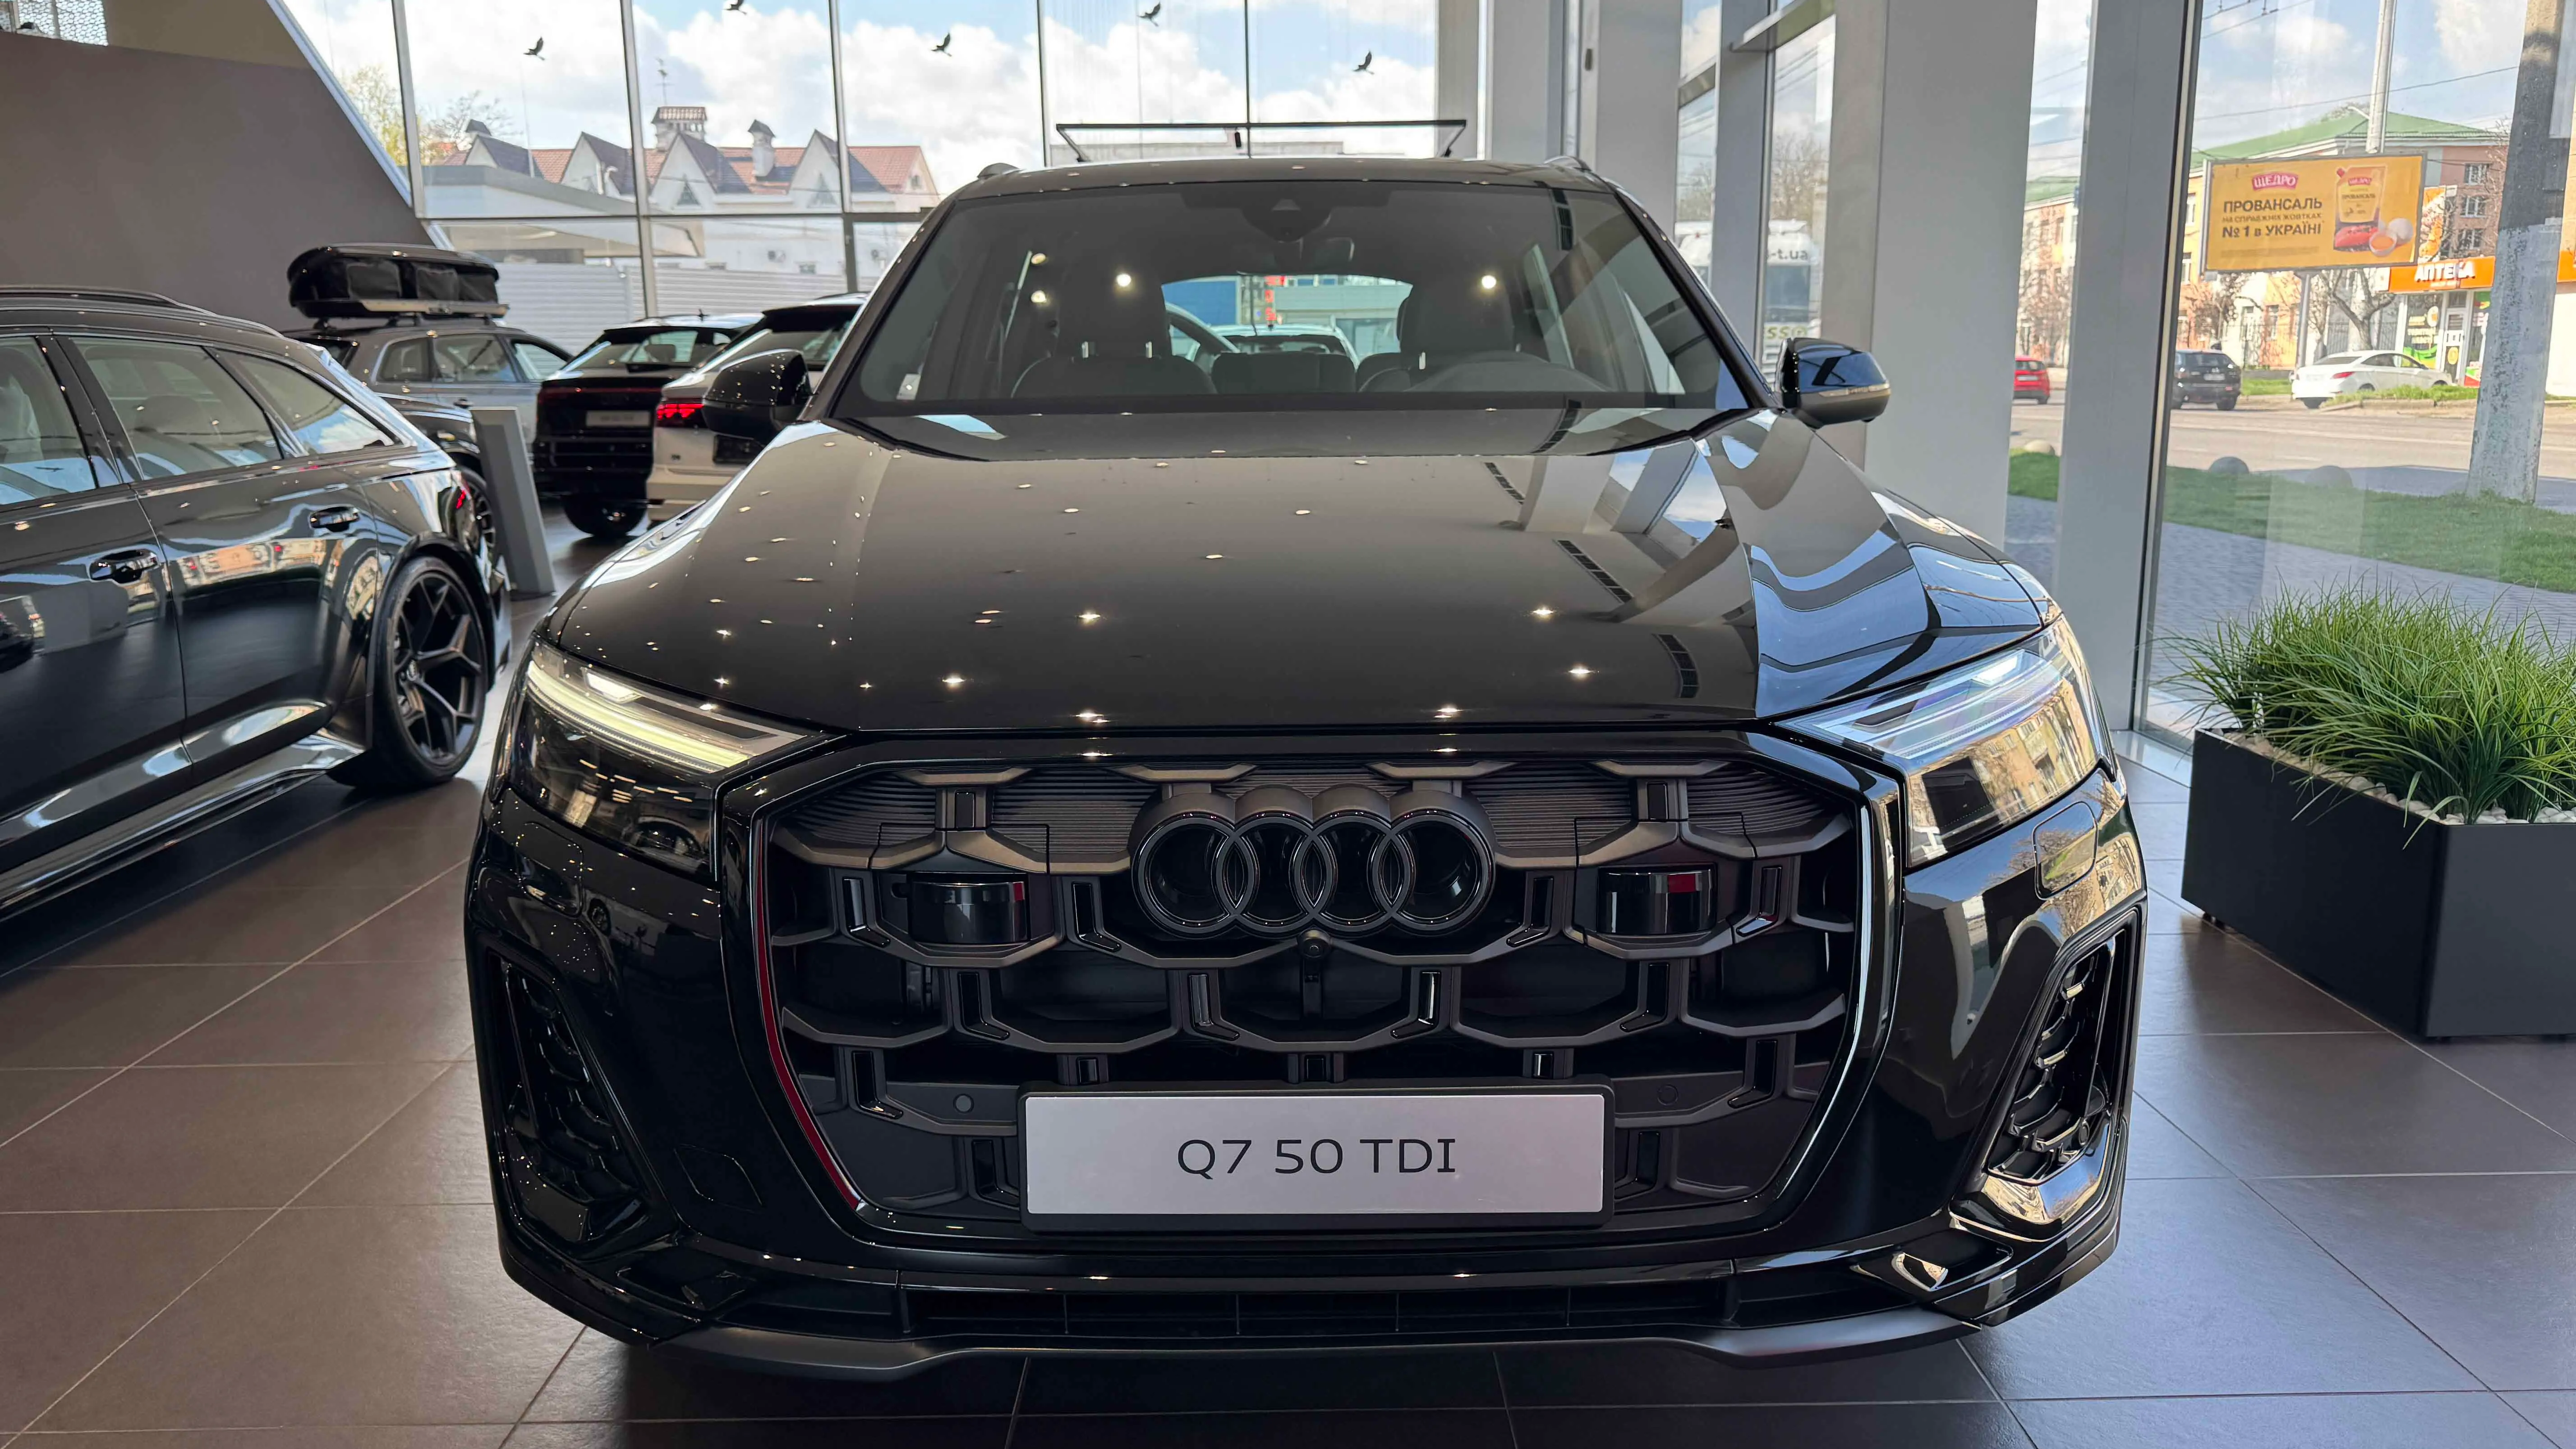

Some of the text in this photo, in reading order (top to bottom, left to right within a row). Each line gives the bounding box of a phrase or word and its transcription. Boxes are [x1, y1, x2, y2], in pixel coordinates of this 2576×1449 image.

[2254, 174, 2296, 188] ЩЕДРО
[2223, 197, 2323, 213] ПРОВАНСАЛЬ
[2266, 221, 2322, 237] УКРАЇНІ
[1765, 248, 1808, 260] -t.ua
[1178, 1138, 1456, 1180] Q7 50 TDI
